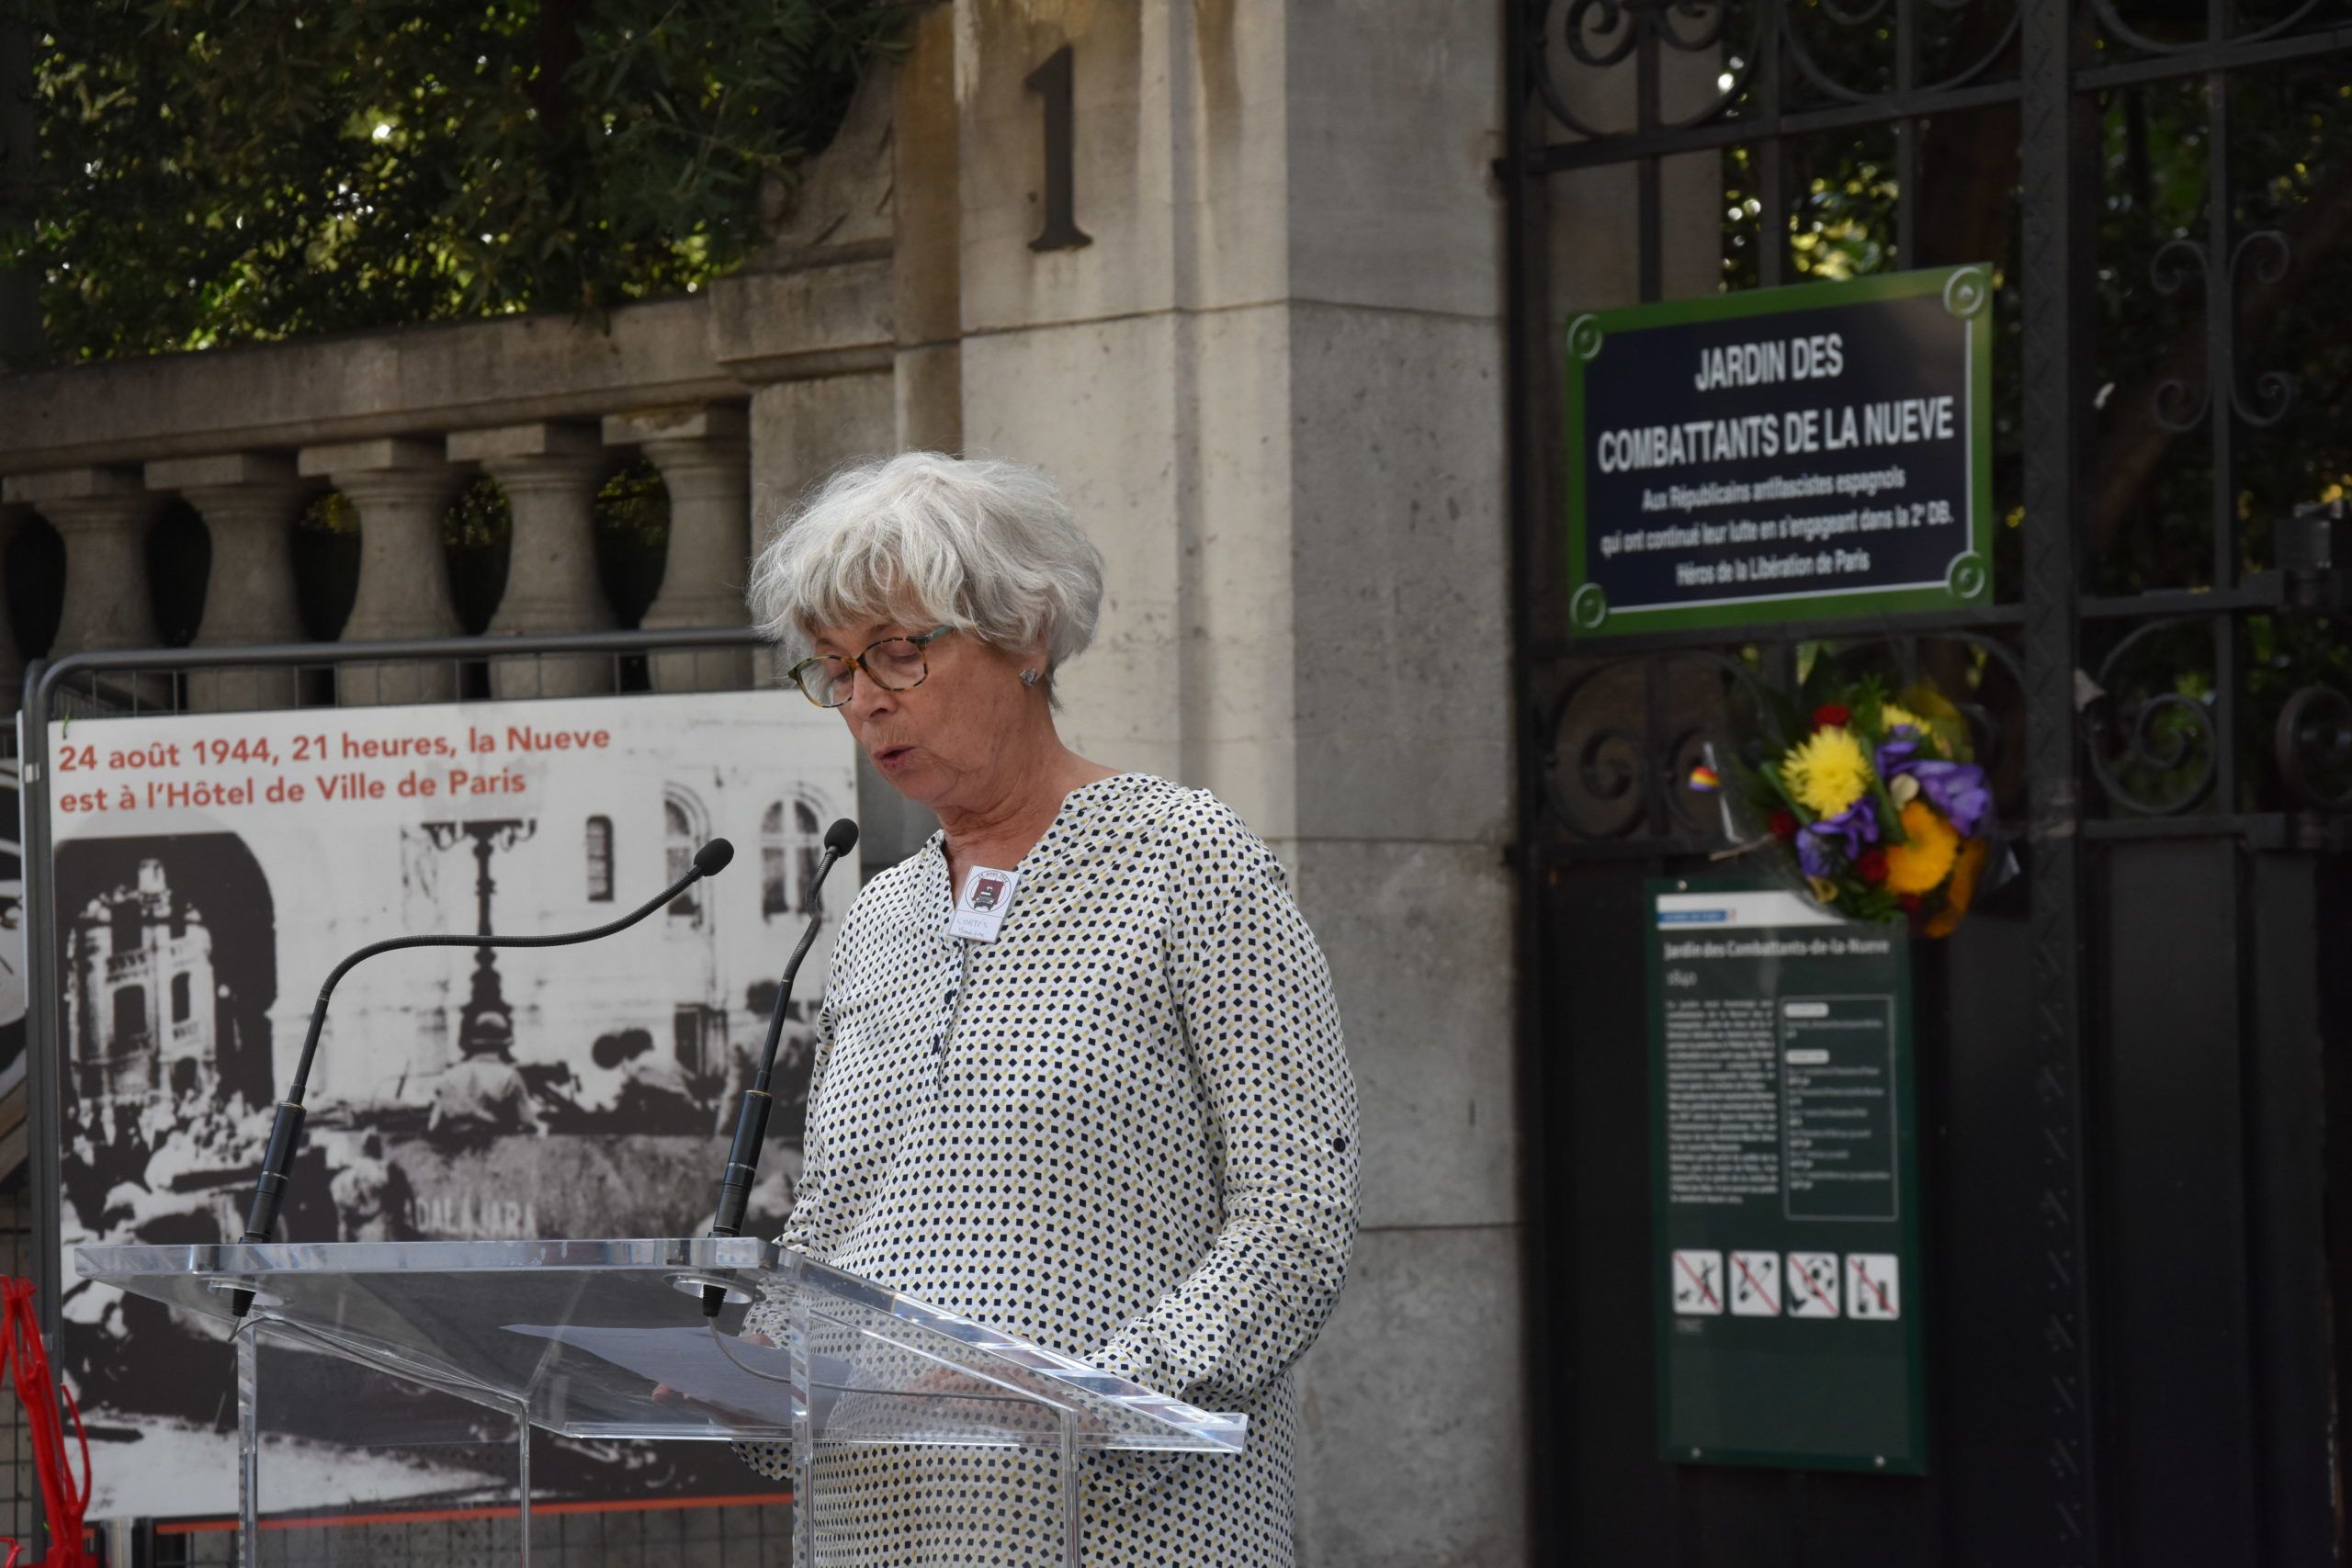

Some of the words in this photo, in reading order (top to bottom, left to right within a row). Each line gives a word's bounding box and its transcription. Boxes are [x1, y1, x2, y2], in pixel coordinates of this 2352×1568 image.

[1023, 42, 1093, 253] 1
[1695, 340, 1786, 391] JARDIN
[1792, 333, 1844, 382] DES
[1598, 413, 1781, 474] COMBATTANTS
[1785, 410, 1819, 456] DE
[1824, 404, 1858, 450] LA
[1863, 396, 1955, 446] NUEVE
[1641, 488, 1668, 512] Aux
[1669, 480, 1752, 513] Républicains
[1753, 473, 1834, 502] antifascistes
[1836, 464, 1906, 498] espagnols
[1600, 530, 1623, 559] qui
[1623, 529, 1645, 553] ont
[1645, 523, 1700, 551] continué
[1702, 523, 1729, 545] leur
[1728, 520, 1758, 544] lutte
[1759, 521, 1778, 541] en
[1860, 507, 1894, 532] dans
[1894, 504, 1910, 528] la
[1676, 561, 1715, 587] Héros
[1716, 558, 1734, 584] de
[1735, 558, 1747, 581] la
[1748, 553, 1815, 581] Libération
[1815, 550, 1834, 575] de
[1834, 547, 1871, 574] Paris
[59, 744, 98, 772] 24
[108, 742, 181, 770] août
[192, 738, 281, 766] 1944,
[291, 734, 327, 761] 21
[341, 731, 458, 760] heures,
[469, 726, 496, 754] la
[507, 726, 611, 753] Nueve
[60, 787, 108, 814] est
[119, 784, 137, 811] à
[265, 776, 306, 804] de
[316, 773, 386, 801] Ville
[397, 770, 437, 798] de
[447, 767, 527, 796] Paris
[1664, 941, 1702, 962] Jardin
[1702, 939, 1726, 958] des
